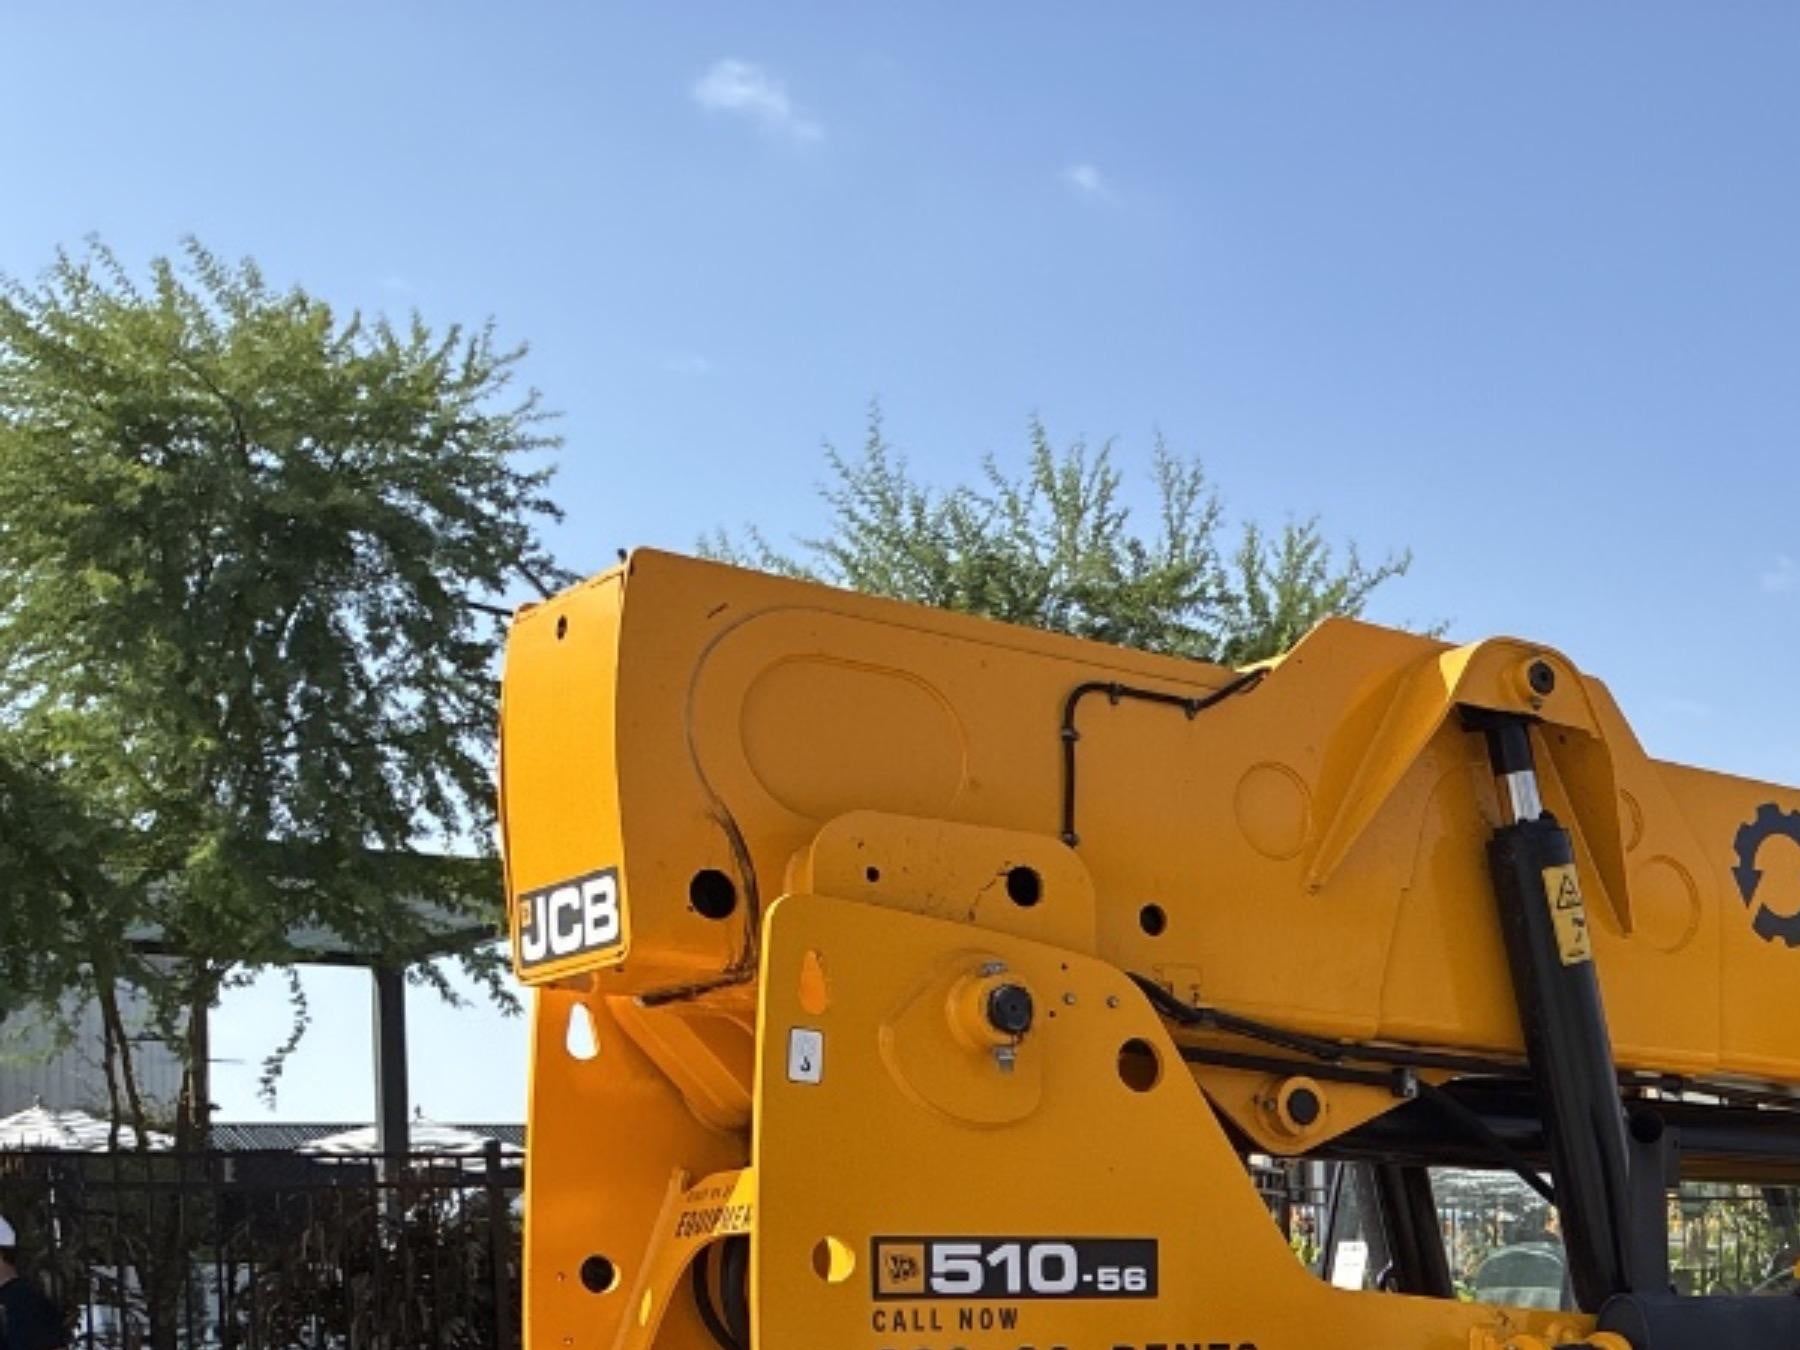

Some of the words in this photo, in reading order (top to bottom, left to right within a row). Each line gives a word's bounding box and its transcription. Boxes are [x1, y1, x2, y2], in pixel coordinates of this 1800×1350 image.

[520, 874, 620, 962] JCB
[872, 1308, 943, 1333] CALL
[958, 1306, 1019, 1331] NOW
